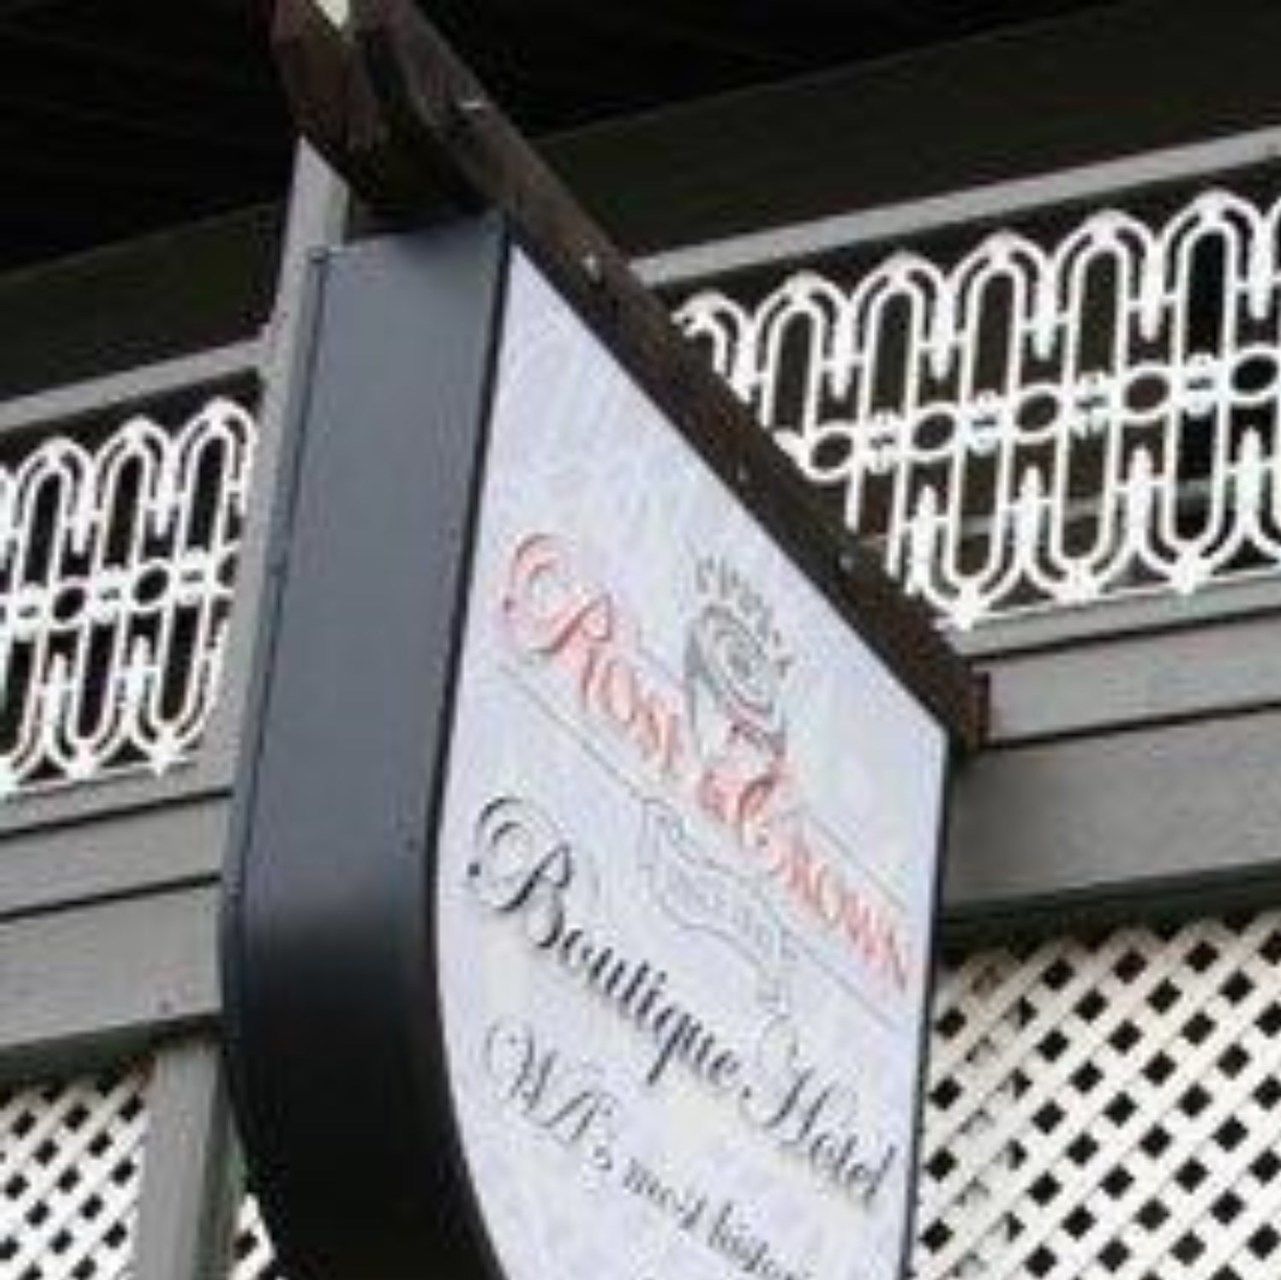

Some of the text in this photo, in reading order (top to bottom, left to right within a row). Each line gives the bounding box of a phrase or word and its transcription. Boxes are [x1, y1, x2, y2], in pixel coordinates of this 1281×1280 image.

[467, 796, 742, 1086] Boutique
[741, 1008, 898, 1206] Hotel
[622, 1156, 706, 1231] most
